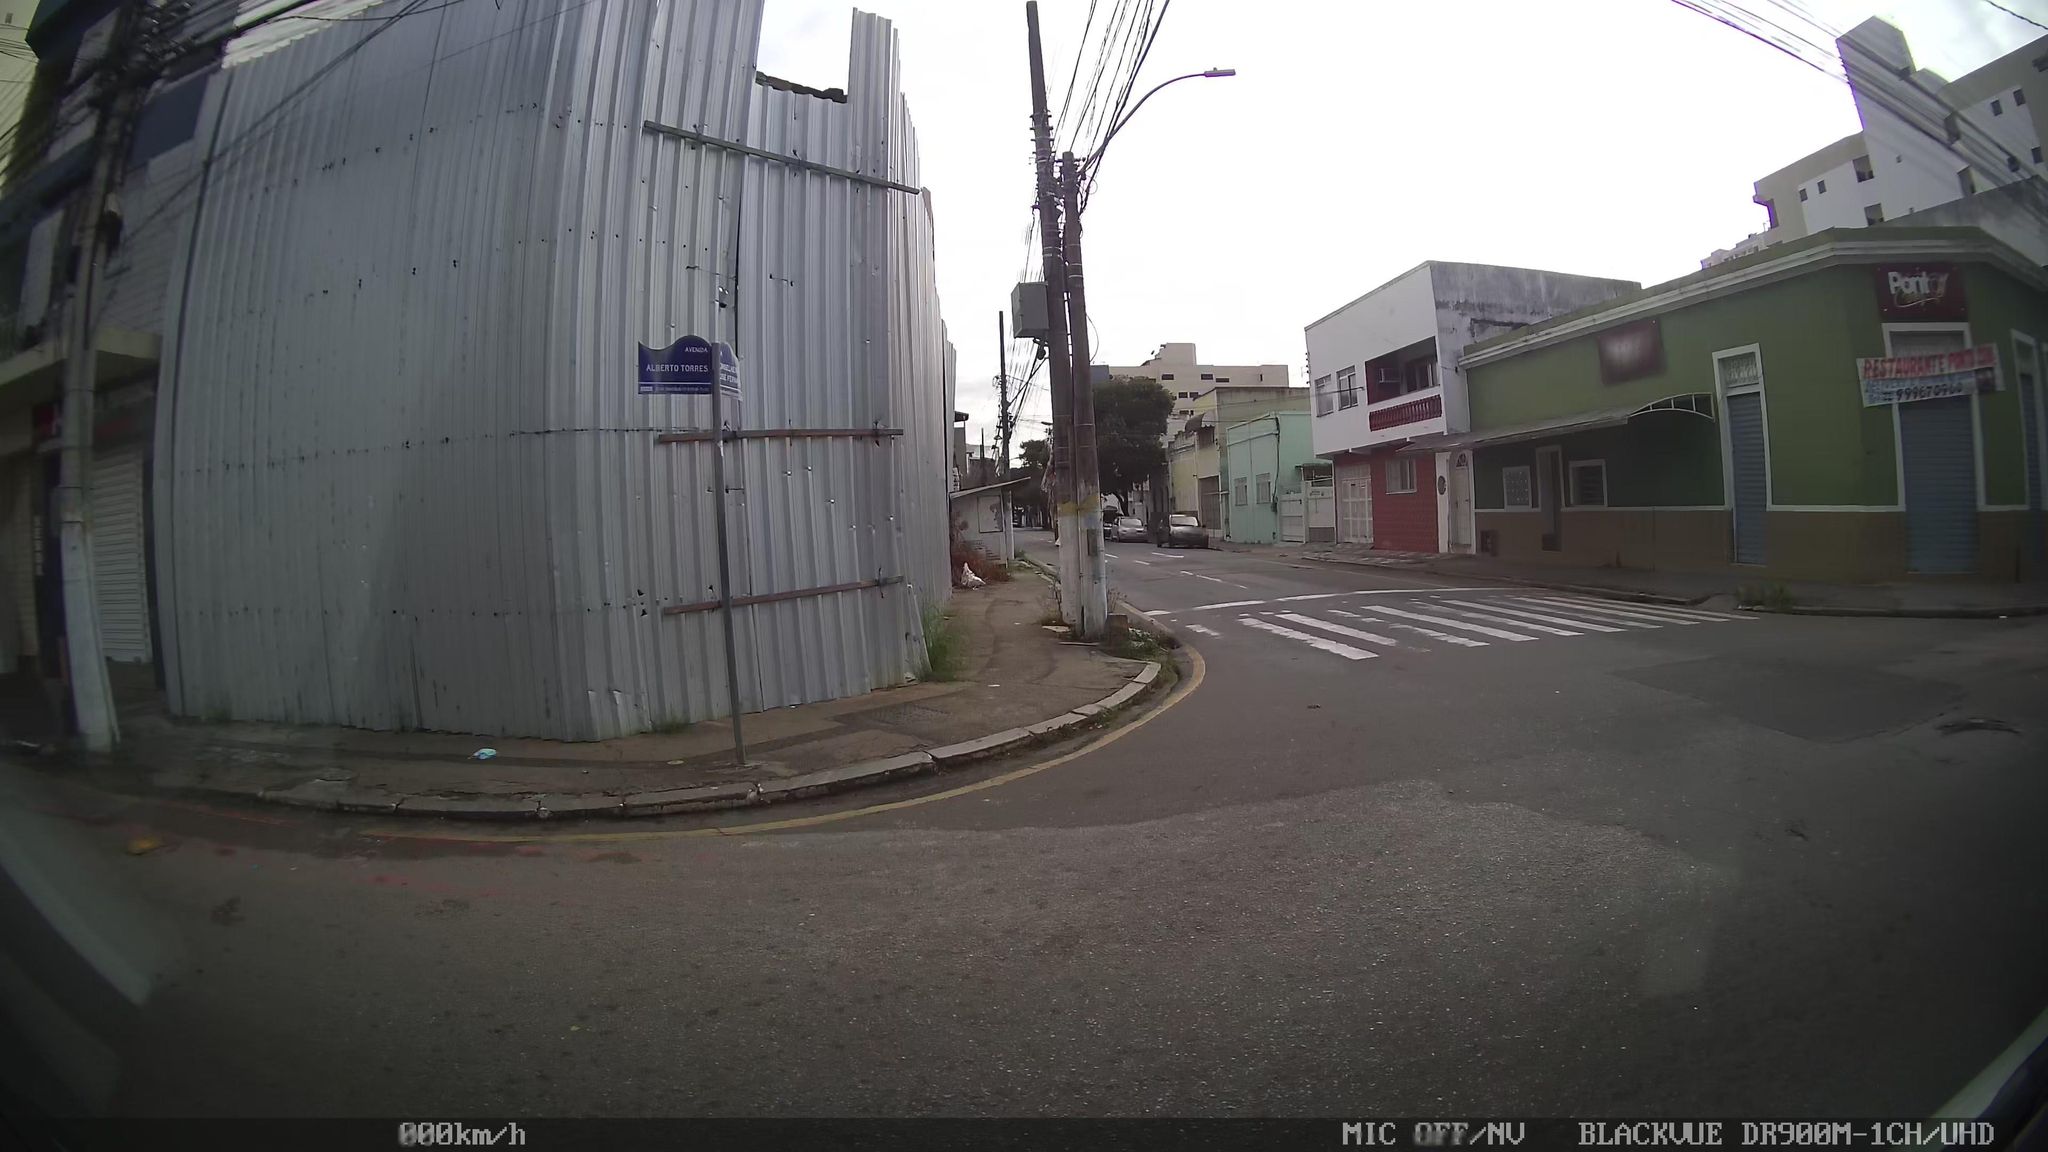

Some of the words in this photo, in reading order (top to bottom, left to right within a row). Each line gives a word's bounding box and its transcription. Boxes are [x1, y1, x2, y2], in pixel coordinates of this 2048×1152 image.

[646, 364, 679, 372] ALBERTO
[681, 364, 709, 372] TORRES
[1864, 354, 1945, 379] RESTAURANTE
